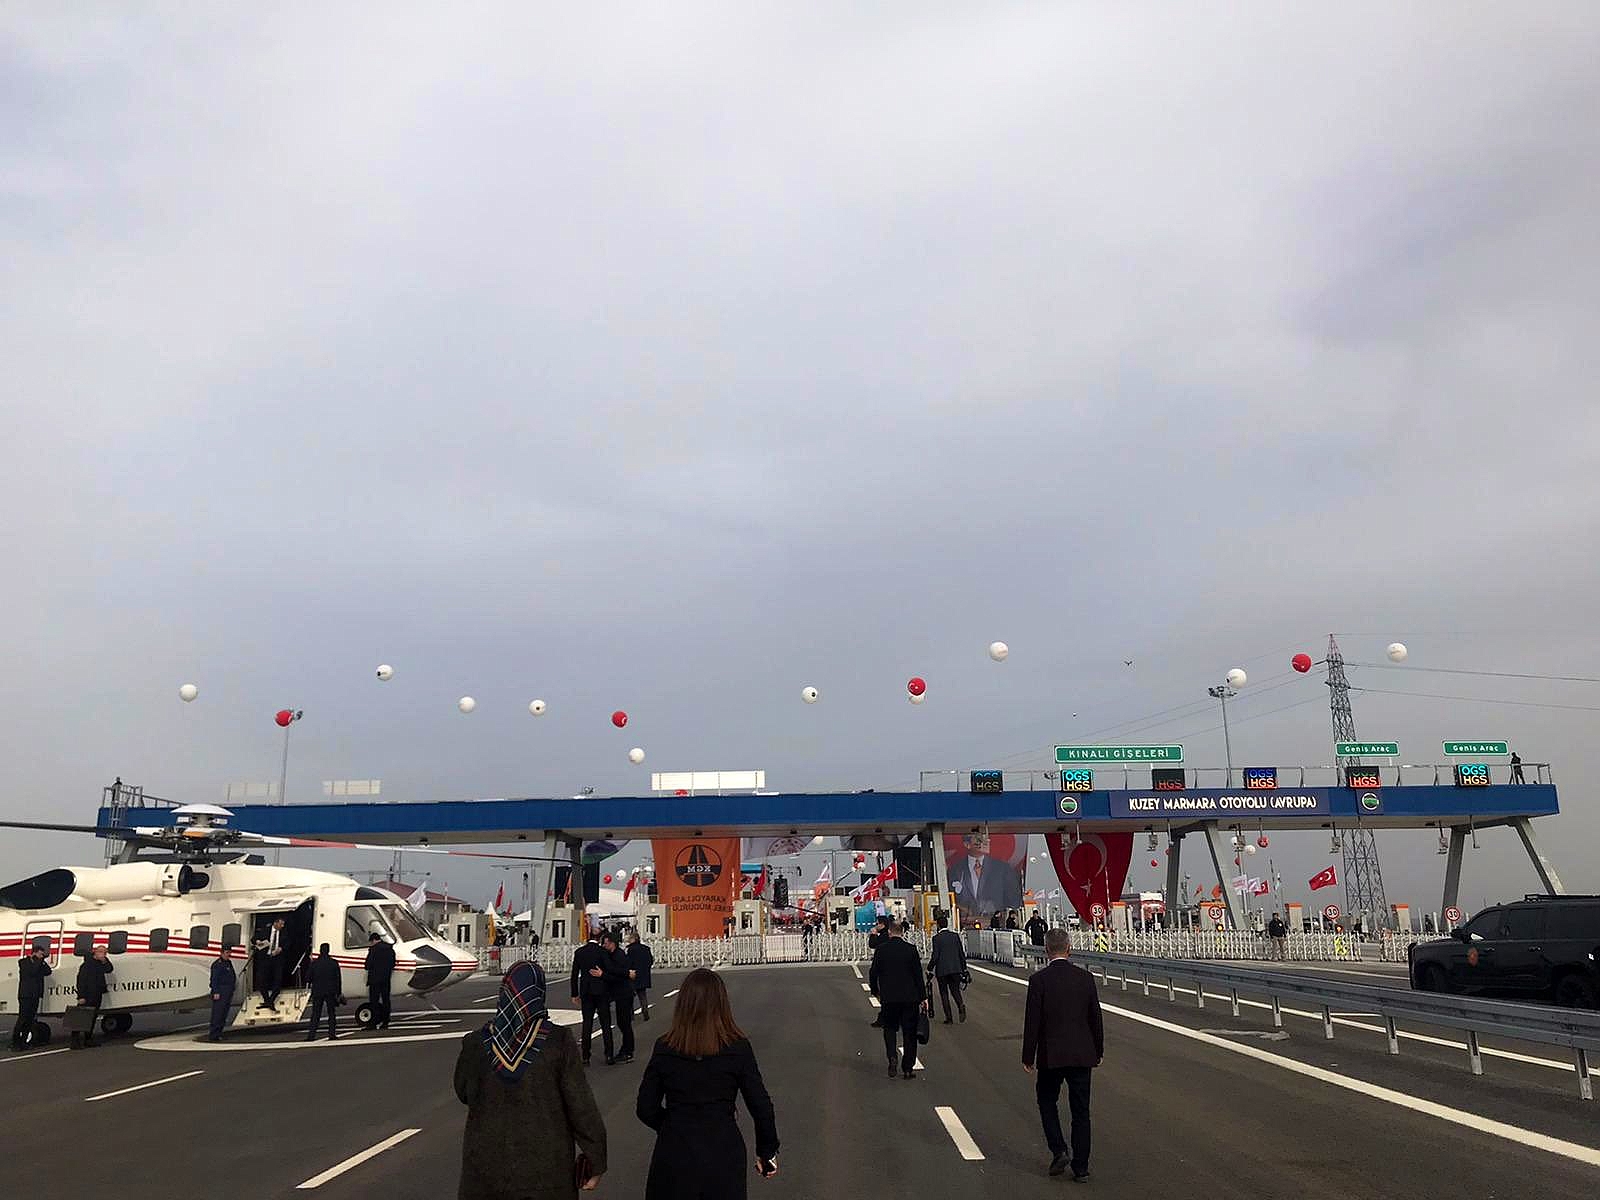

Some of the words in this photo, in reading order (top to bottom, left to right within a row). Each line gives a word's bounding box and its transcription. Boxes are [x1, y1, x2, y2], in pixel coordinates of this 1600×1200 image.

[1371, 745, 1390, 753] Araç
[1479, 744, 1499, 752] Araç
[1069, 749, 1109, 758] KINALI
[1114, 747, 1169, 759] GİŞELERİ
[1249, 769, 1274, 778] OGS
[1461, 766, 1486, 775] OGS
[1065, 770, 1090, 781] OGS
[1463, 775, 1488, 785] HGS
[1158, 779, 1183, 790] HGS
[1250, 778, 1275, 788] HGS
[1353, 776, 1377, 785] HGS
[976, 781, 1000, 791] HGS
[1066, 781, 1091, 790] HGS
[1129, 797, 1160, 810] KUZEY
[1163, 797, 1217, 810] MARMARA
[1219, 796, 1267, 809] OTOYOLU
[1270, 795, 1317, 809] (AVRUPA)
[1093, 905, 1102, 914] 30
[1211, 908, 1220, 917] 30
[1328, 908, 1337, 917] 30
[1448, 909, 1458, 918] 30
[48, 984, 78, 996] TÜRK
